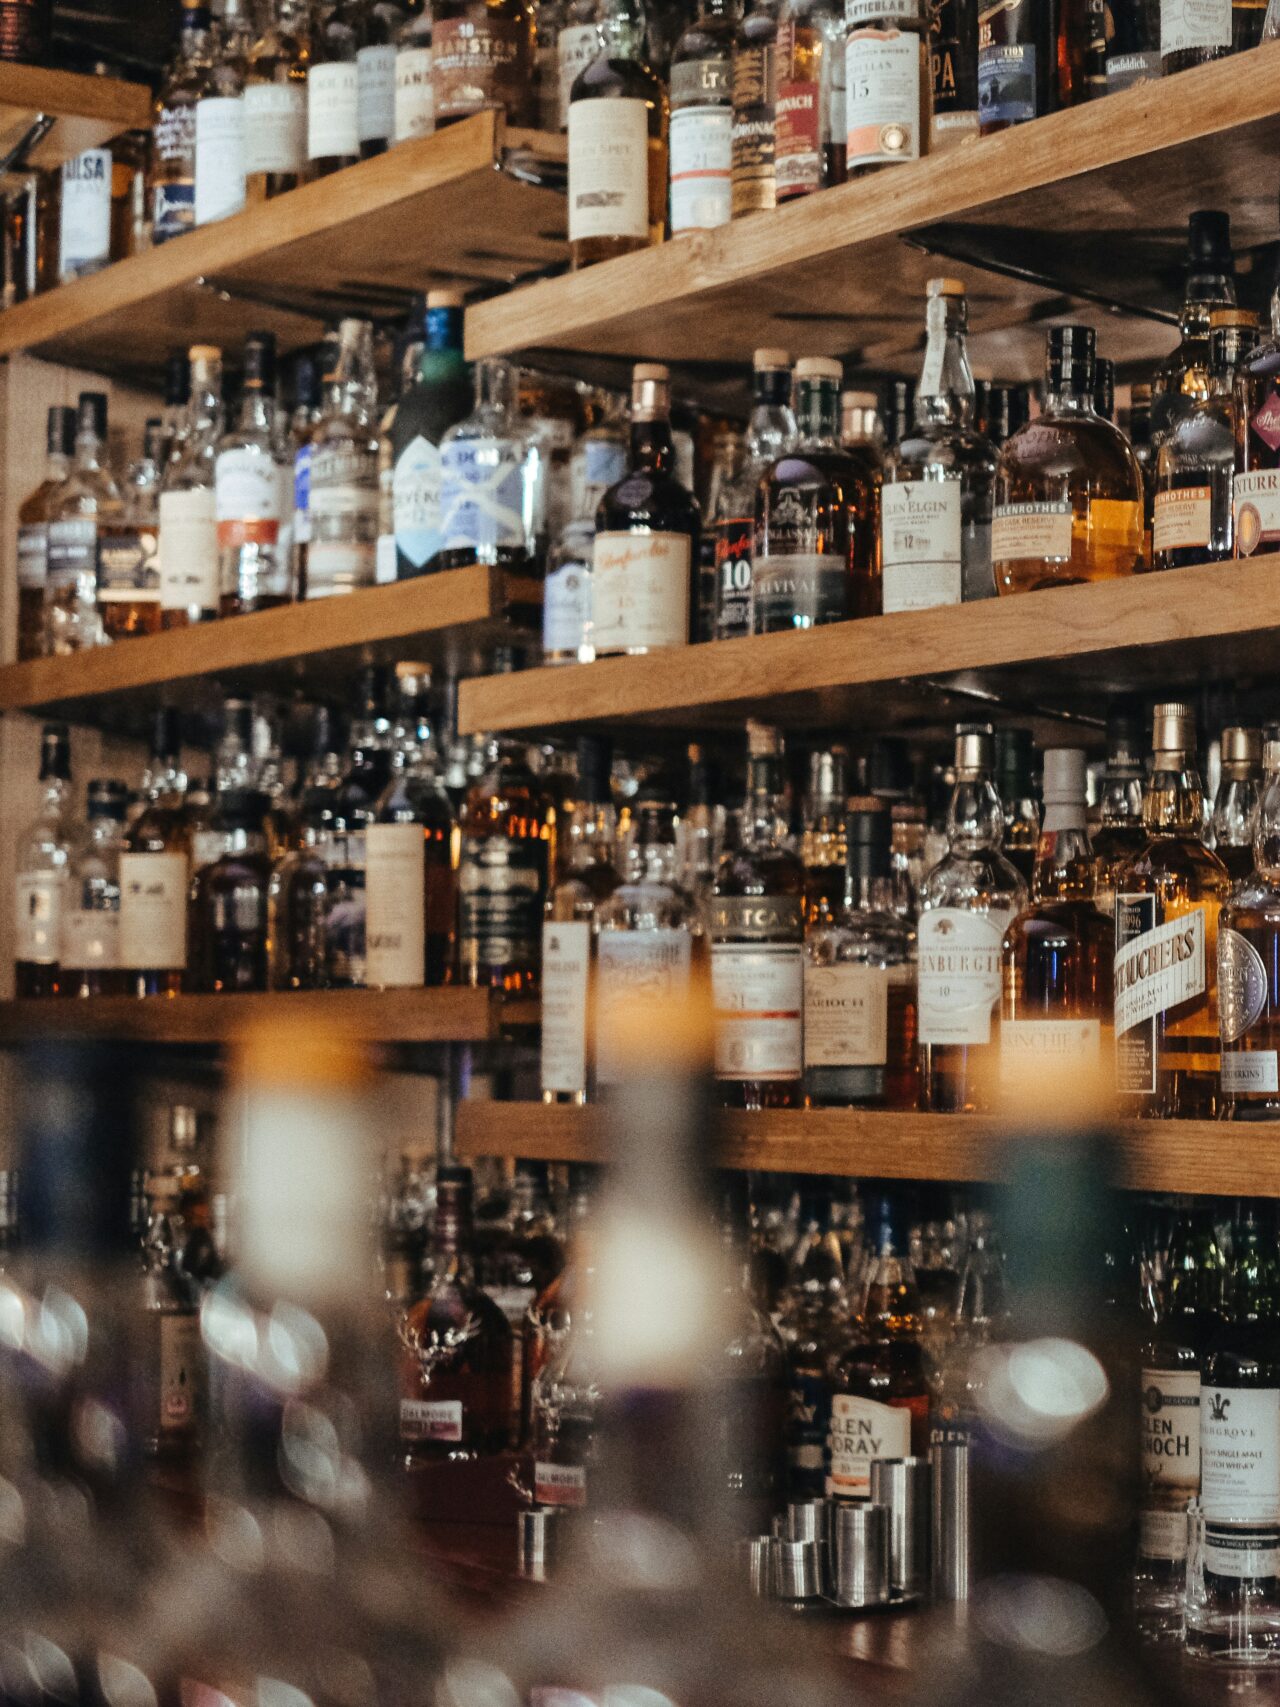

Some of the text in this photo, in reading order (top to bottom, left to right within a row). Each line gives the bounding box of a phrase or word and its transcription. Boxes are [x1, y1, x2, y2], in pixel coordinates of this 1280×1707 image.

[851, 79, 870, 101] 15
[908, 500, 948, 513] ELGIN
[904, 533, 914, 550] 12
[721, 559, 751, 591] 10
